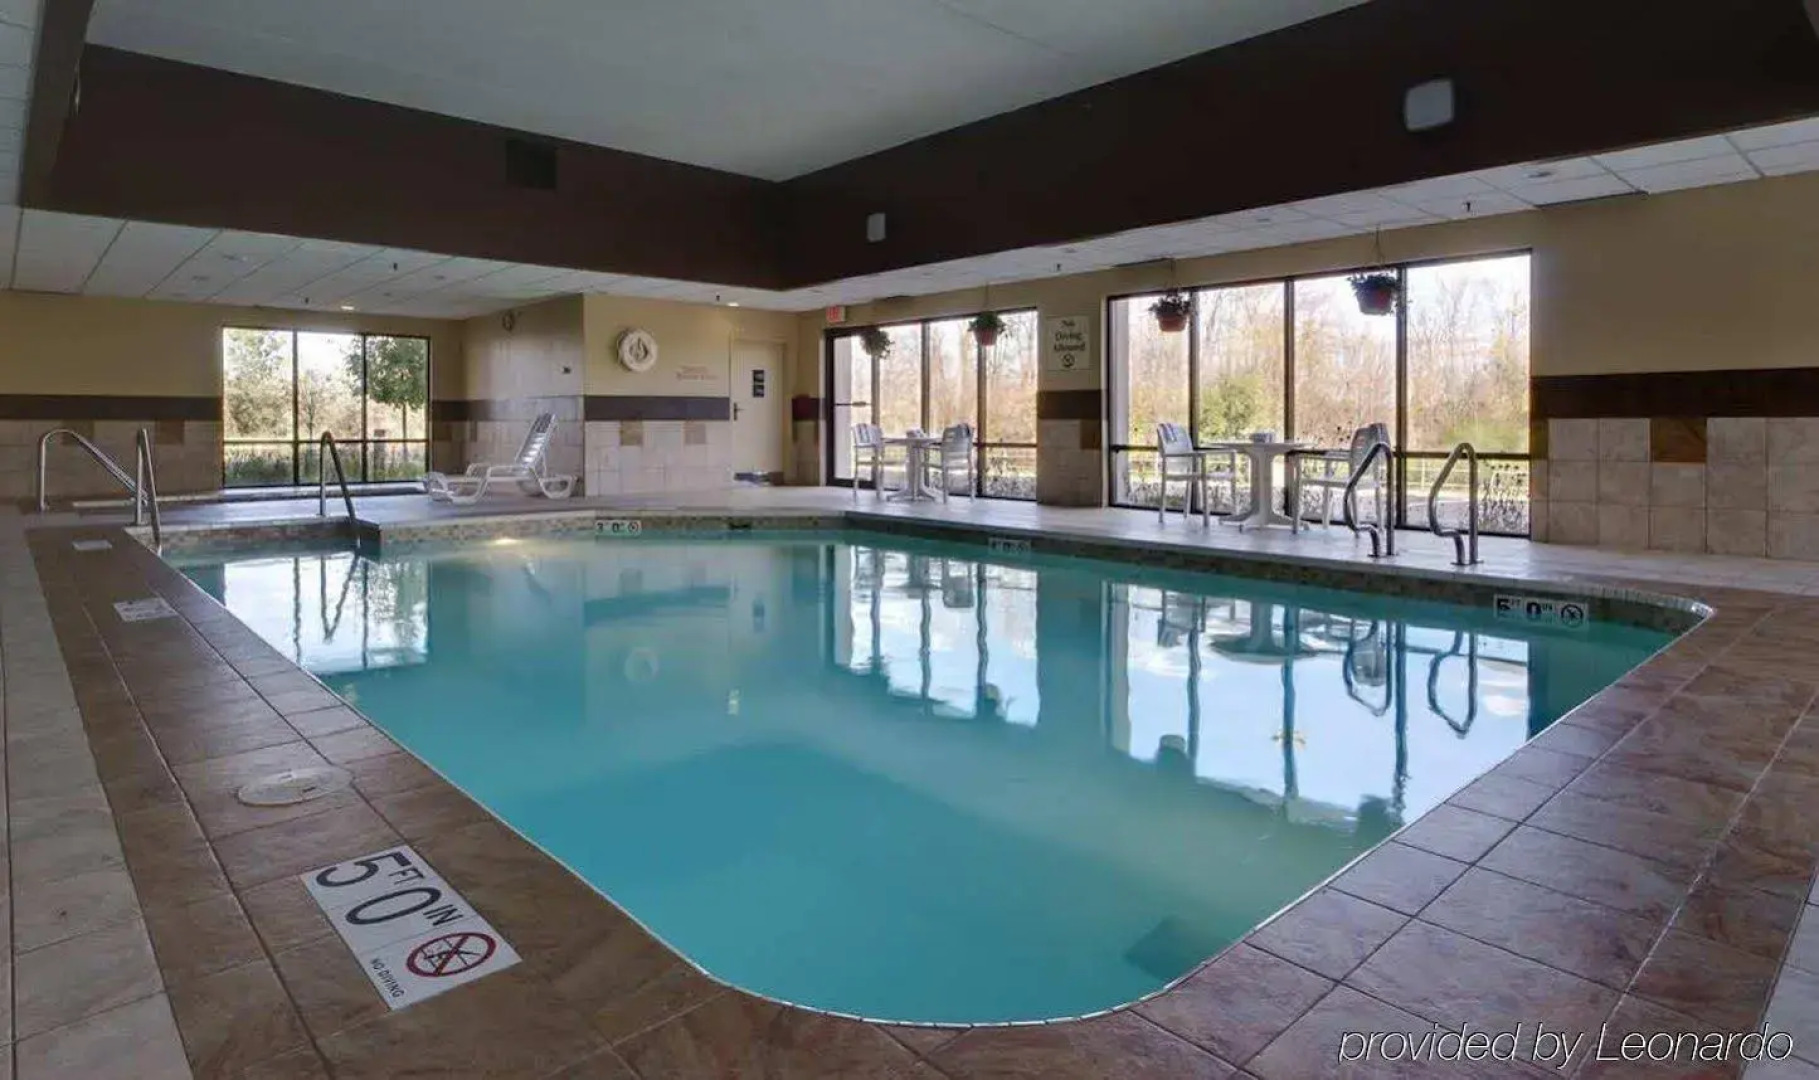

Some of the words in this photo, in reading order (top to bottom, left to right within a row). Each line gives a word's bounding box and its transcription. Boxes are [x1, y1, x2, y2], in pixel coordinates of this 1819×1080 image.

[315, 852, 411, 887] 5
[388, 867, 425, 885] FT
[345, 887, 442, 925] 0
[423, 904, 464, 926] IN
[370, 958, 385, 970] NO
[377, 969, 405, 998] DIVING
